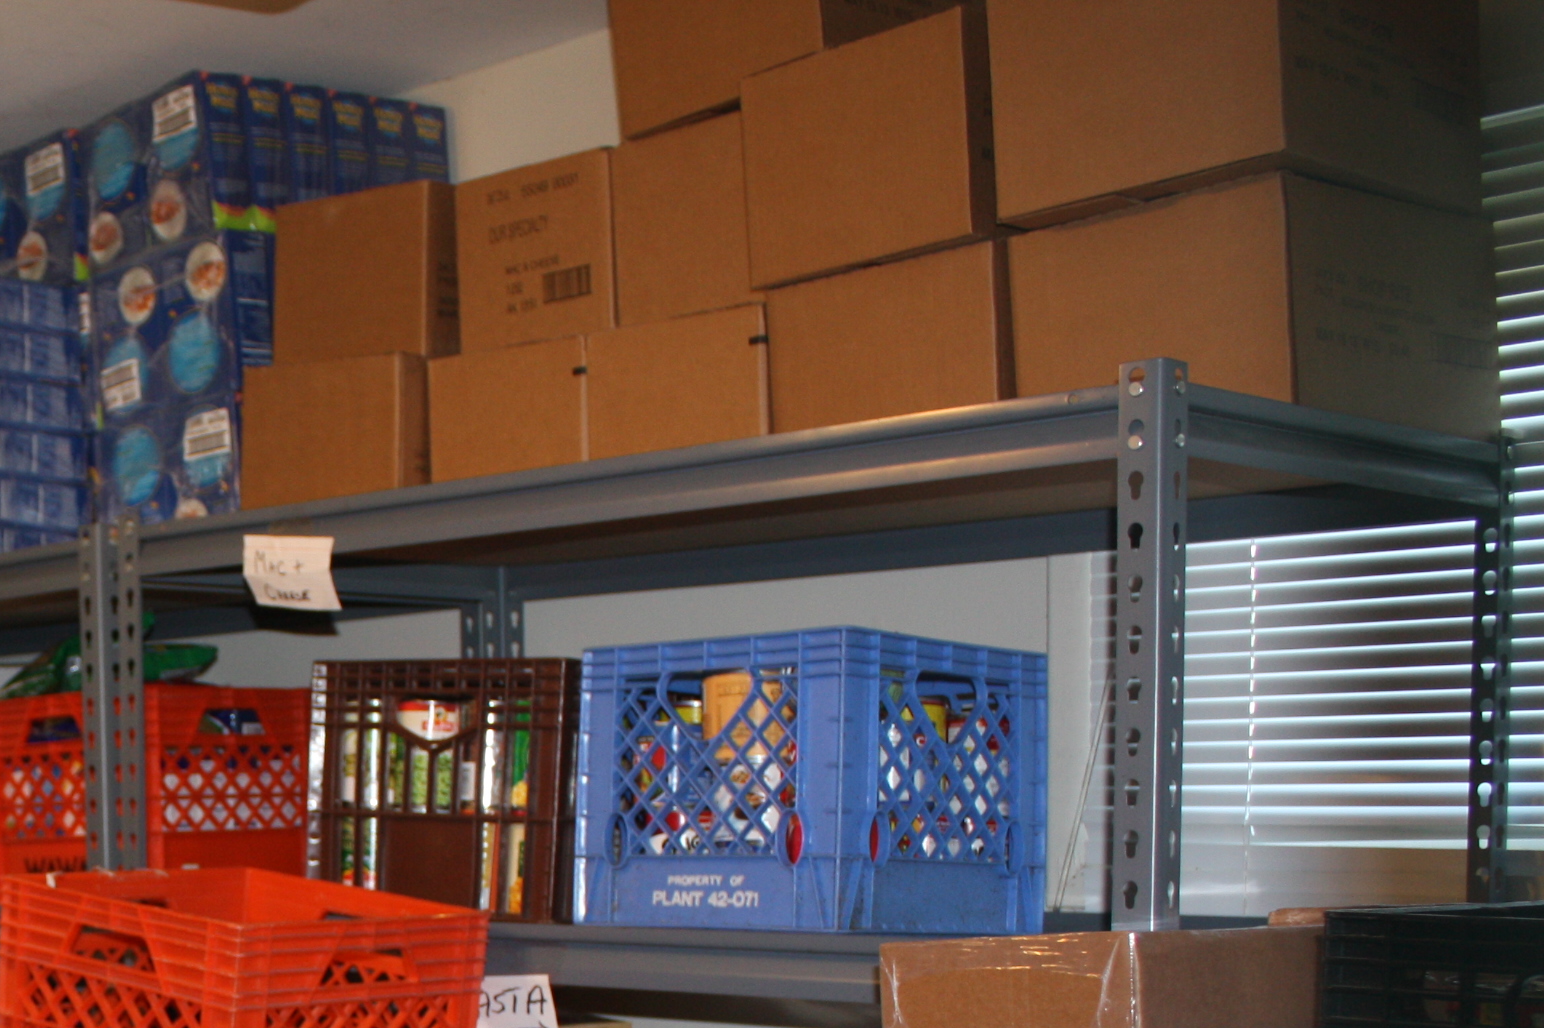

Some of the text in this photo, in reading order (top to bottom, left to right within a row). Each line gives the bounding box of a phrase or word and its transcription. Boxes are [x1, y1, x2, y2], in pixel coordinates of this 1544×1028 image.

[667, 875, 744, 887] PROPERTY OF
[652, 890, 759, 907] PLANT 42-071
[479, 984, 547, 1018] ASTA
